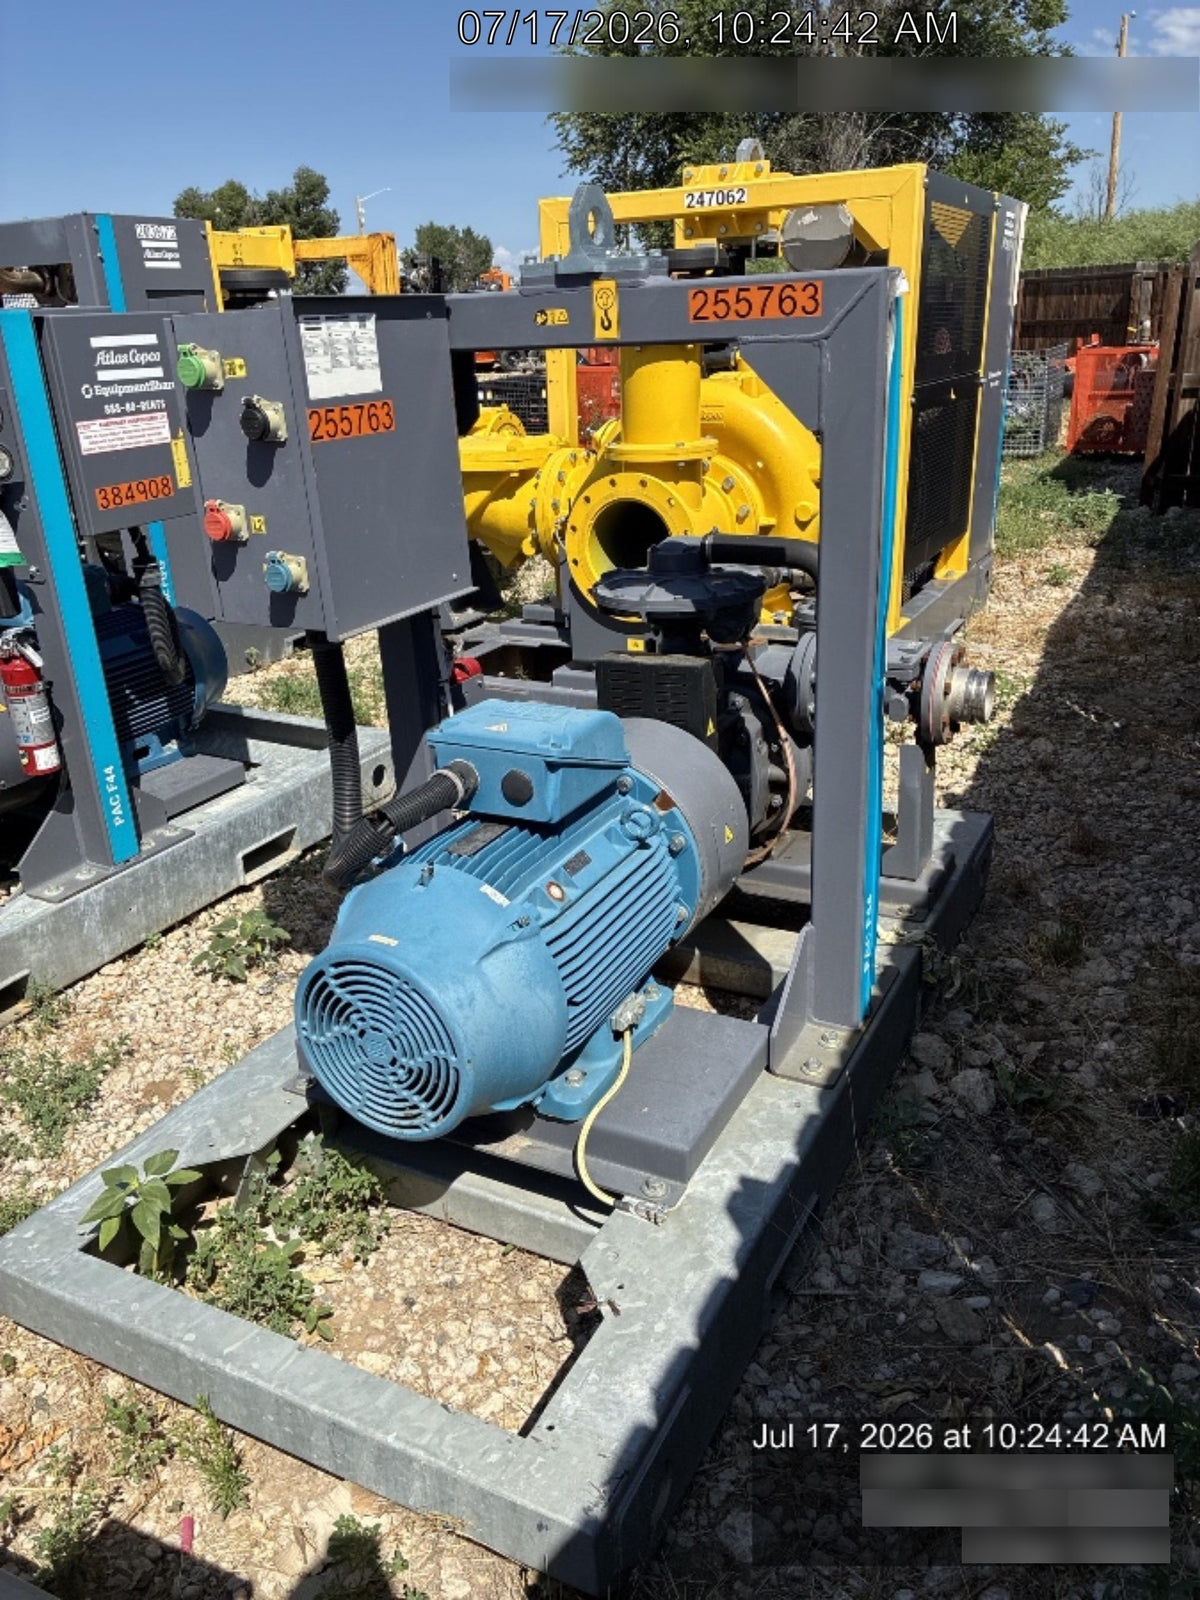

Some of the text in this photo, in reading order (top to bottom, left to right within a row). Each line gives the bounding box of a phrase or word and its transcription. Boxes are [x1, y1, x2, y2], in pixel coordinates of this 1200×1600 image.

[686, 188, 746, 209] 247062
[691, 282, 821, 321] 255763
[94, 347, 161, 367] Atlas Copco
[308, 401, 394, 441] 255763
[98, 476, 172, 509] 384908
[103, 765, 125, 828] PAC F44
